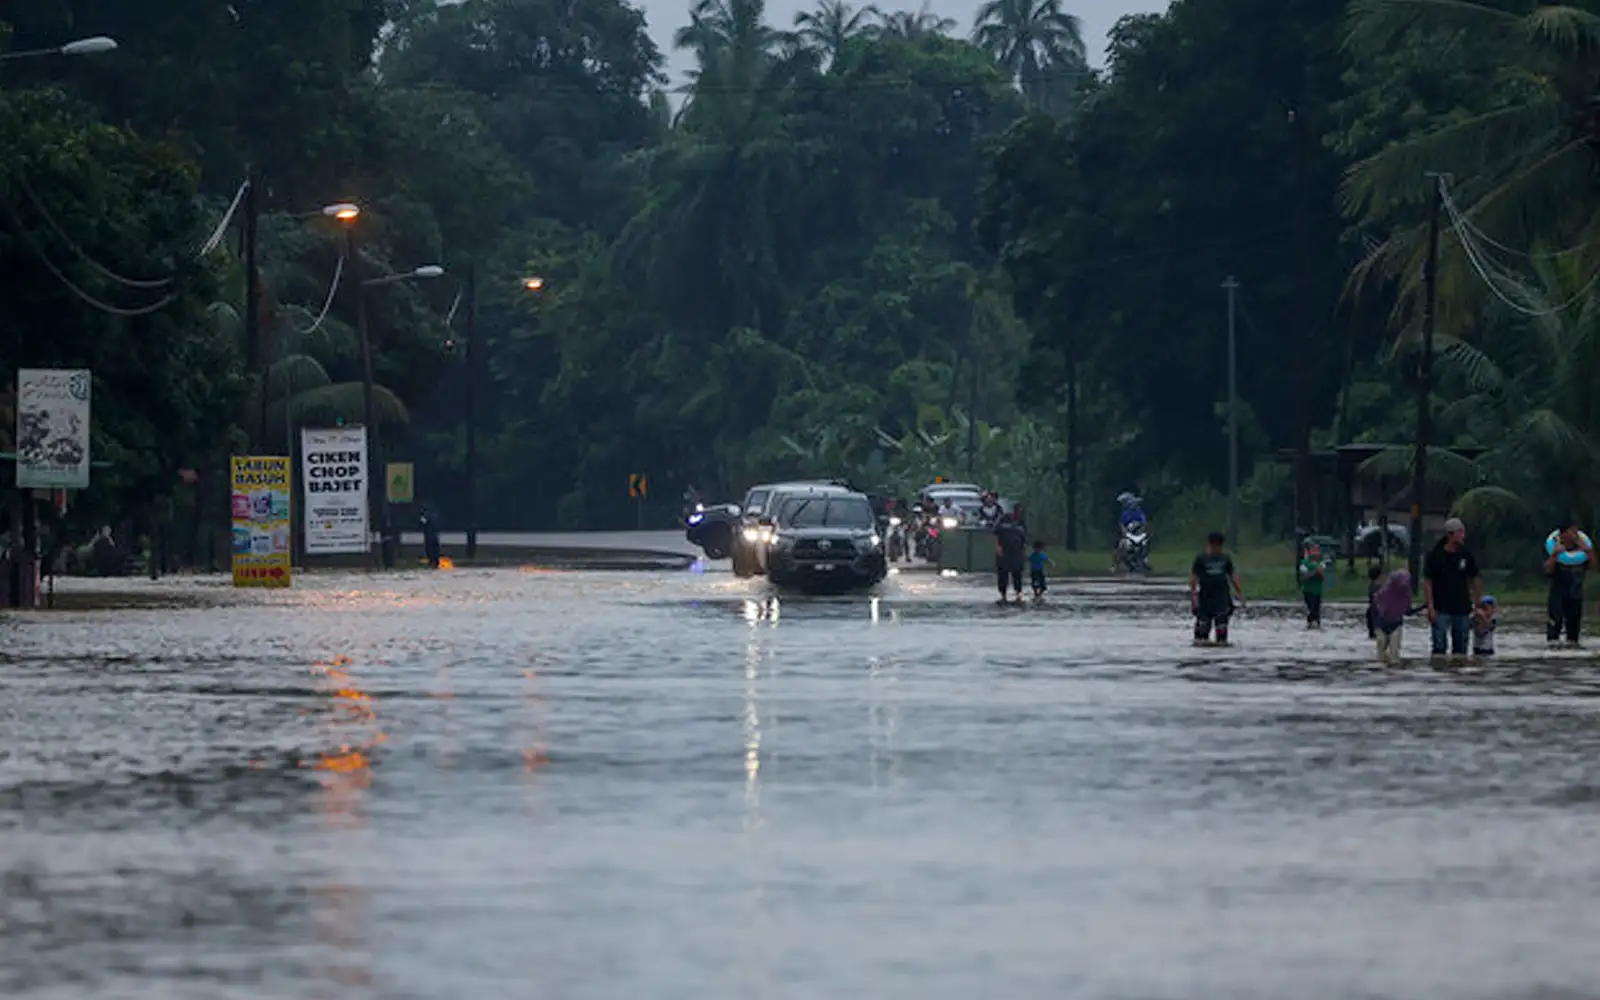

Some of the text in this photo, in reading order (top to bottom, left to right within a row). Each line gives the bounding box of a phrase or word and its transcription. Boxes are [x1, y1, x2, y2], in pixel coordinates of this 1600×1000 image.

[307, 452, 361, 464] CIKEN
[309, 465, 360, 478] CHOP
[308, 479, 362, 493] BAJET
